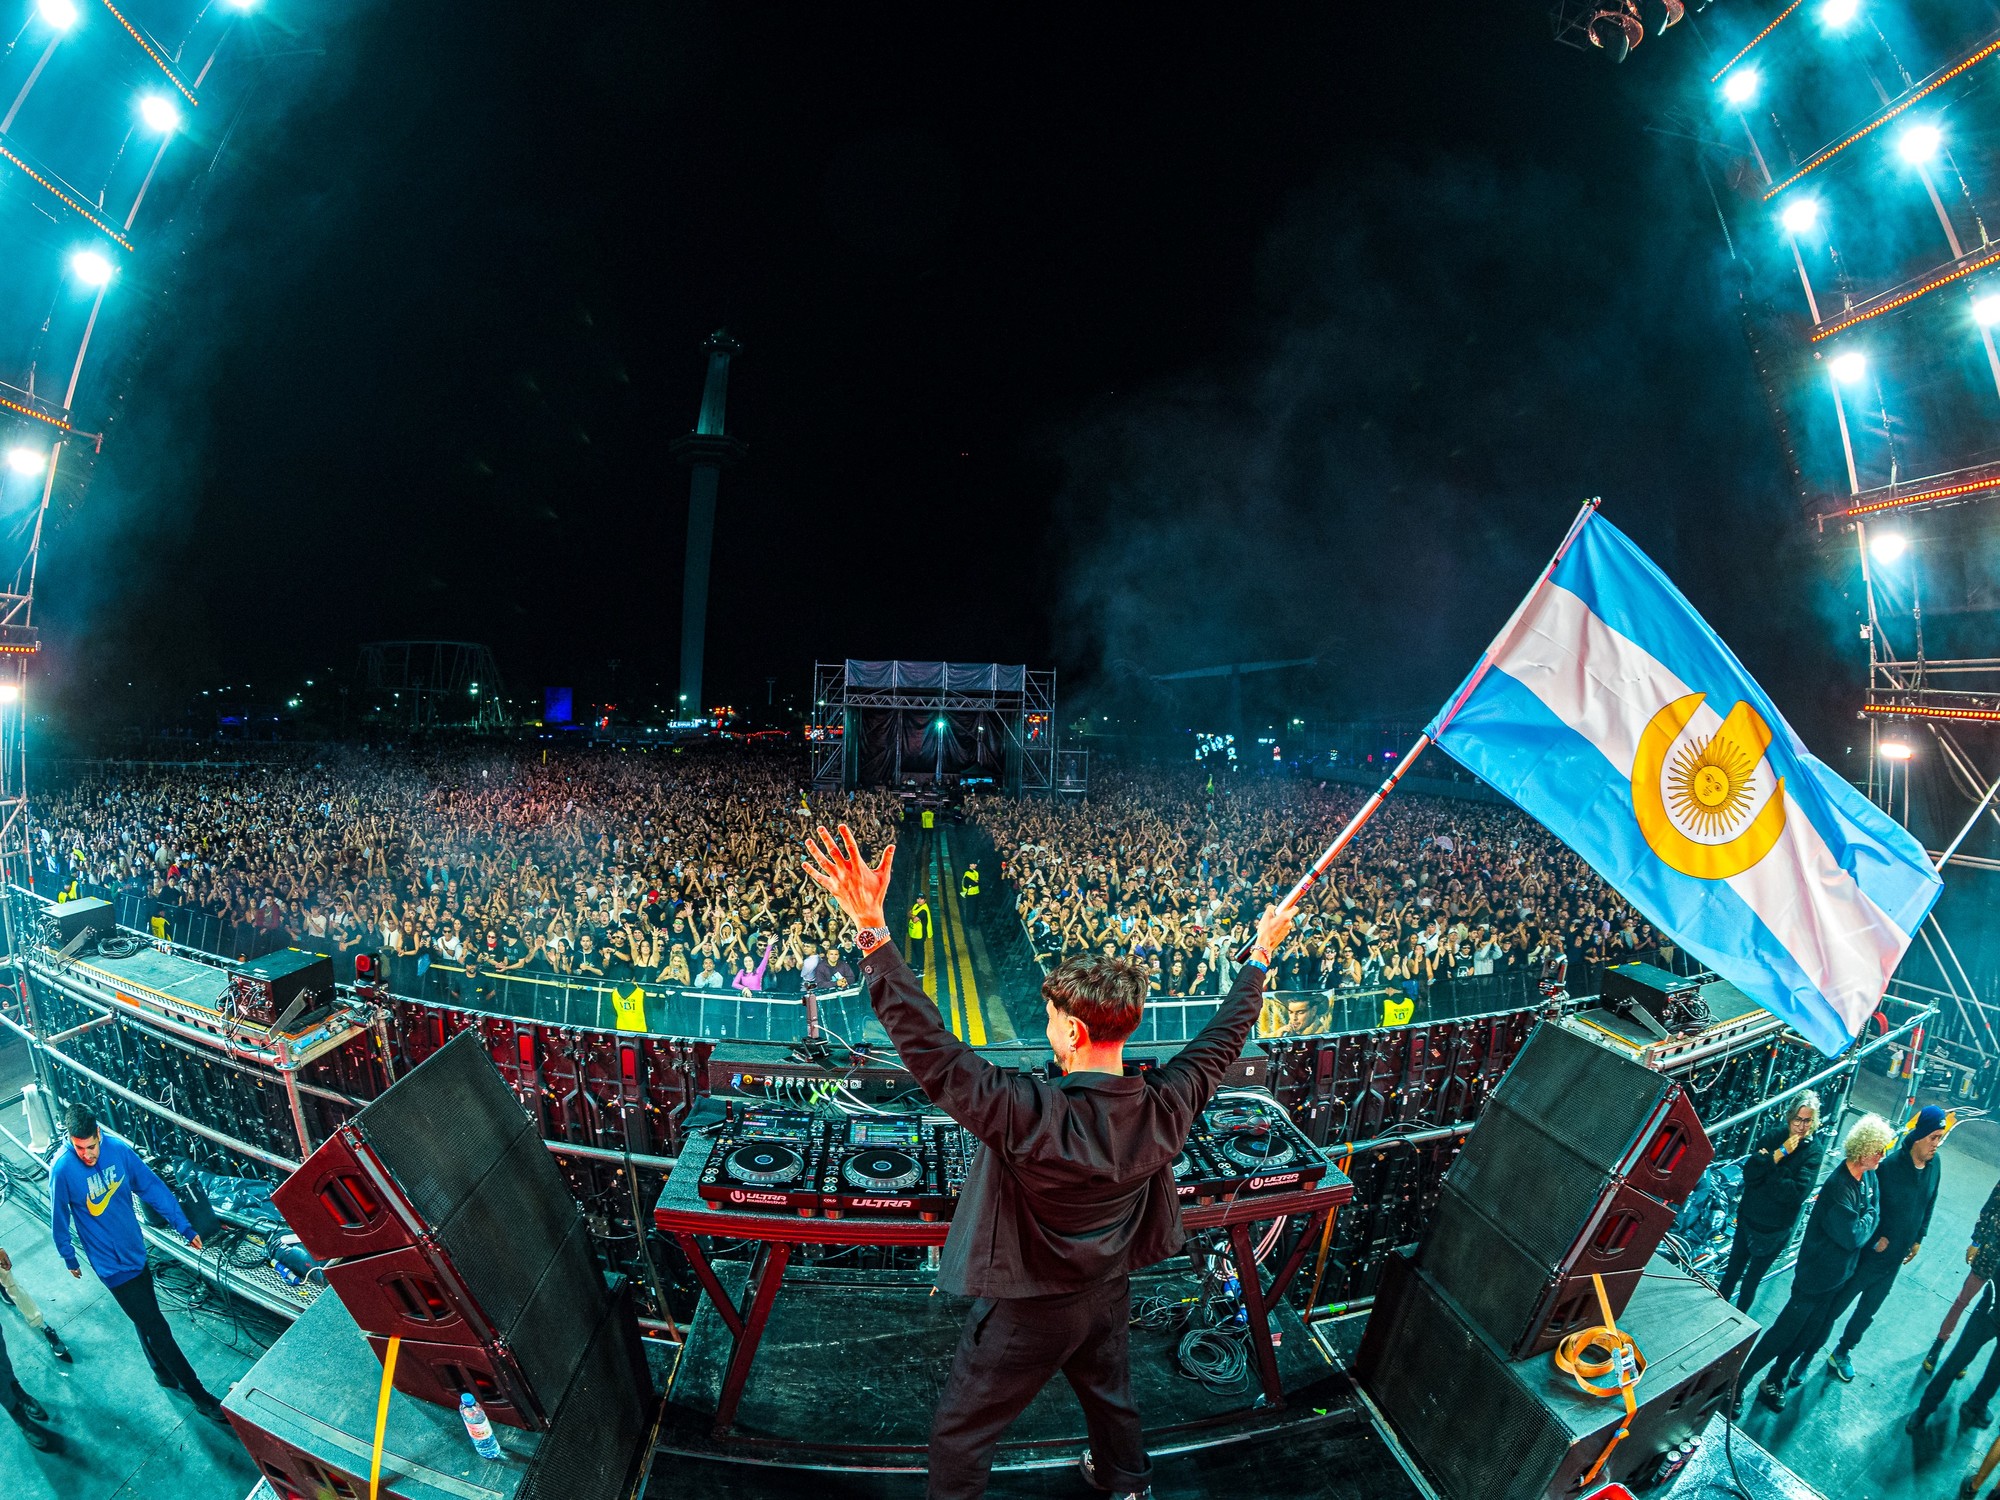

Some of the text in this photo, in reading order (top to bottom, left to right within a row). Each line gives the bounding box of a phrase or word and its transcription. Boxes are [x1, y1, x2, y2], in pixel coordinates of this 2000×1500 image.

[86, 1164, 117, 1201] NIKE
[1264, 1173, 1300, 1183] ULTRA
[746, 1192, 787, 1201] ULTRA
[852, 1199, 912, 1208] ULTRA
